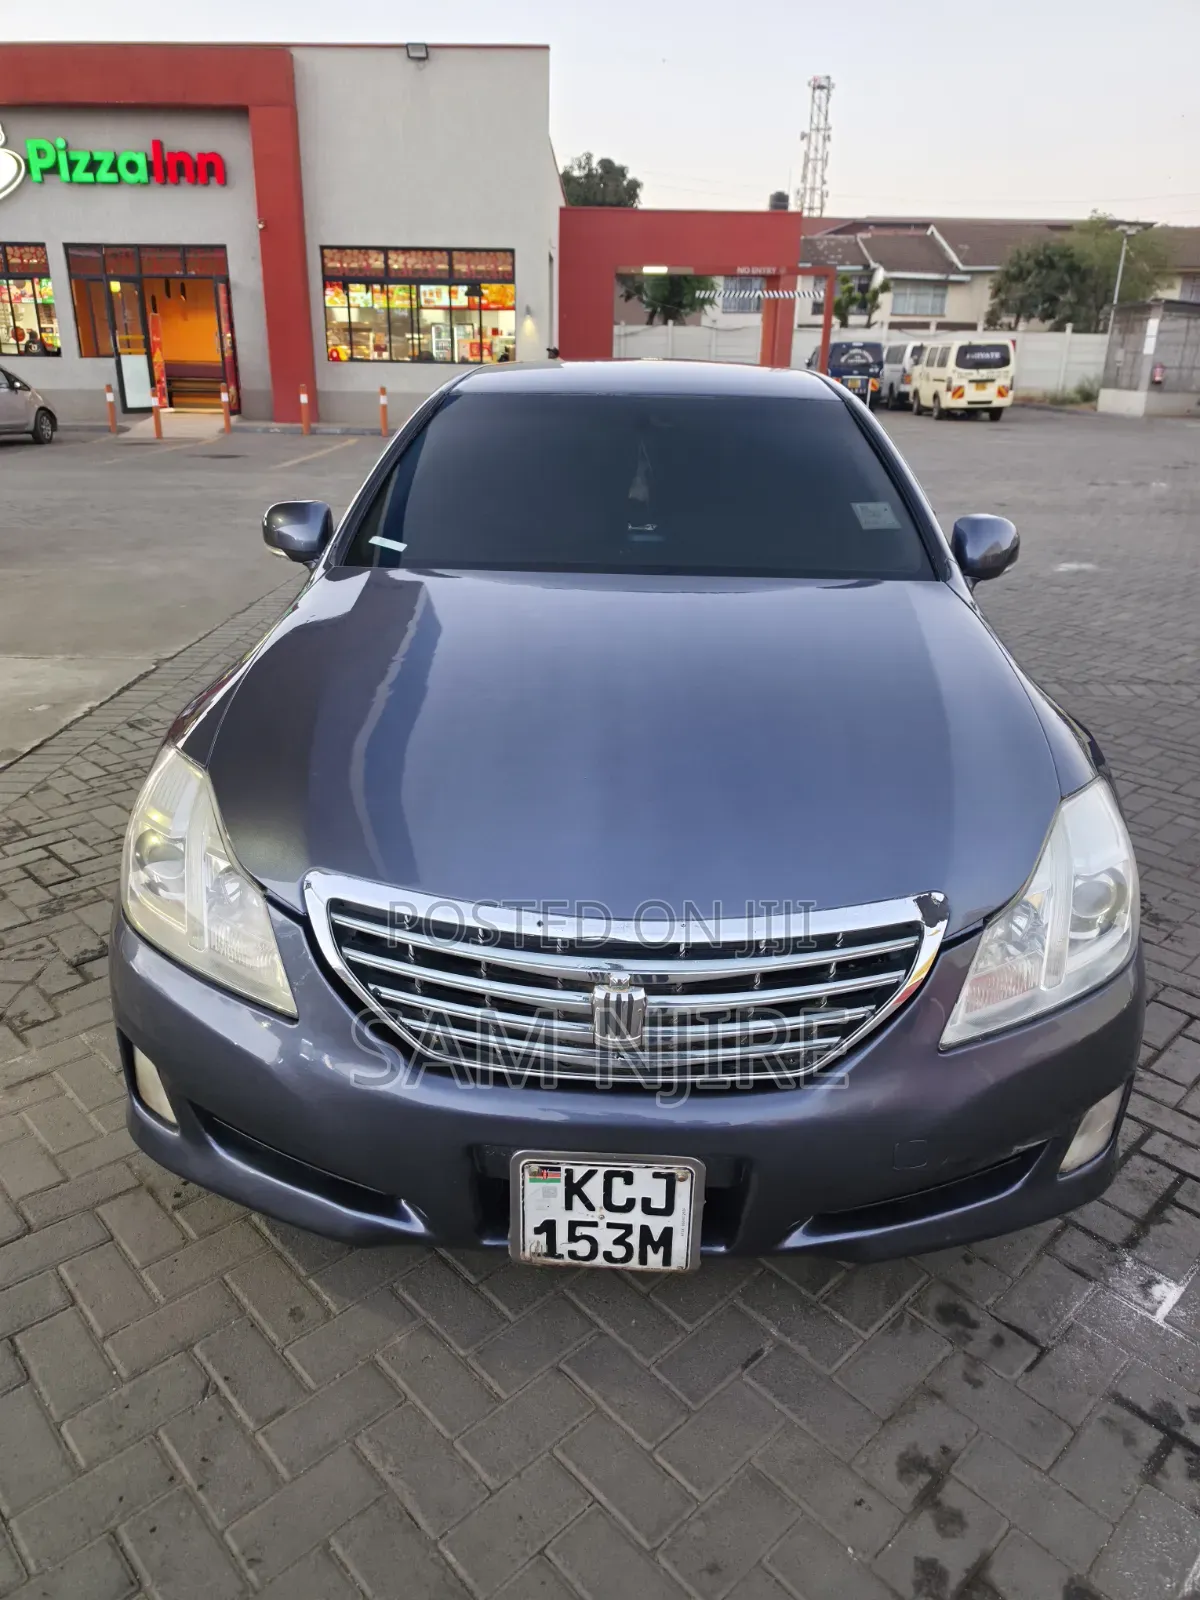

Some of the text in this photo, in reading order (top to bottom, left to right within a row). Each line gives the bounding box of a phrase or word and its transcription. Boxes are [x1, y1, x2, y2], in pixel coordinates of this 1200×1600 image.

[736, 266, 777, 275] NO ENTRY
[563, 1168, 677, 1217] KCJ
[533, 1219, 674, 1267] 153M
